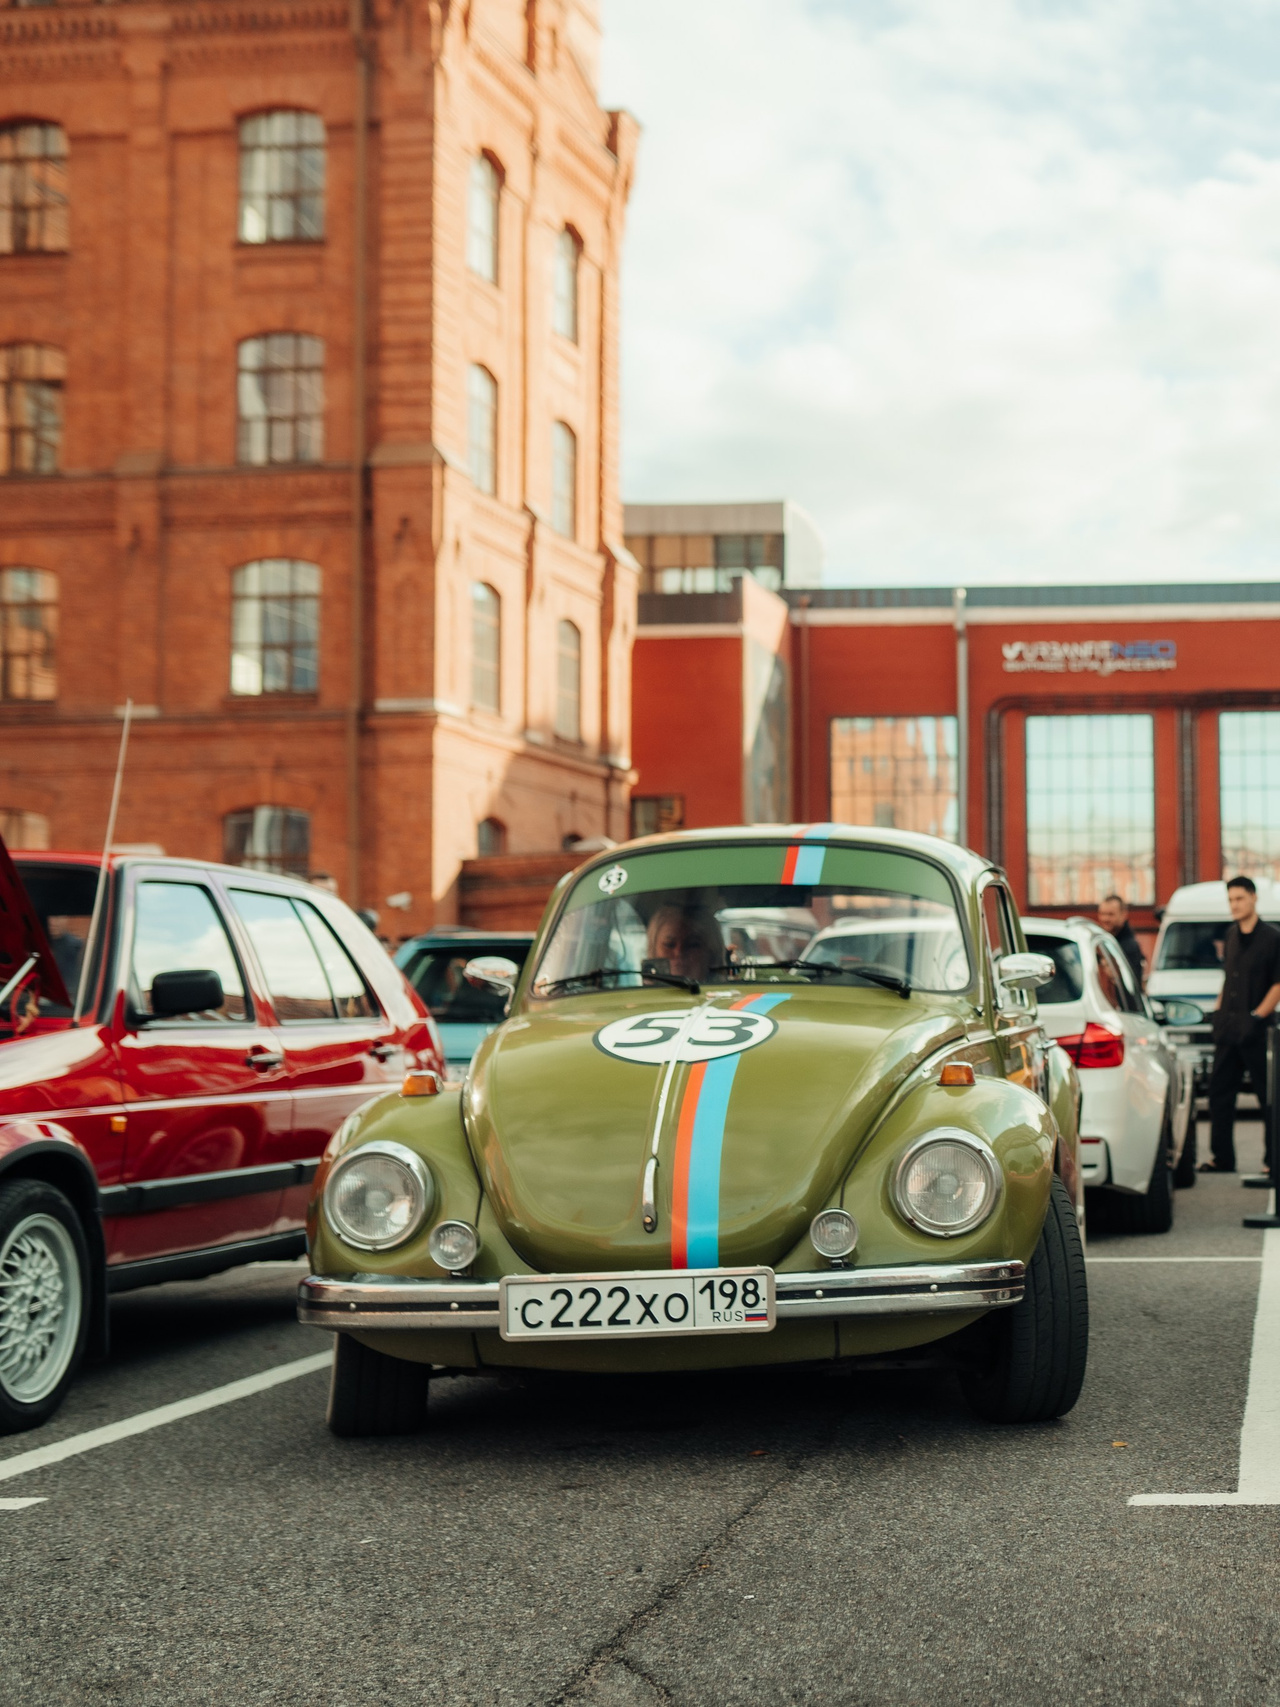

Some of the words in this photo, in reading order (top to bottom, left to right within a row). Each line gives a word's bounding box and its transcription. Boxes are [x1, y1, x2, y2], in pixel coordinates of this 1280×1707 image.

[602, 871, 623, 889] 53
[613, 1014, 760, 1048] 53
[699, 1278, 760, 1310] 198
[712, 1310, 743, 1323] RUS
